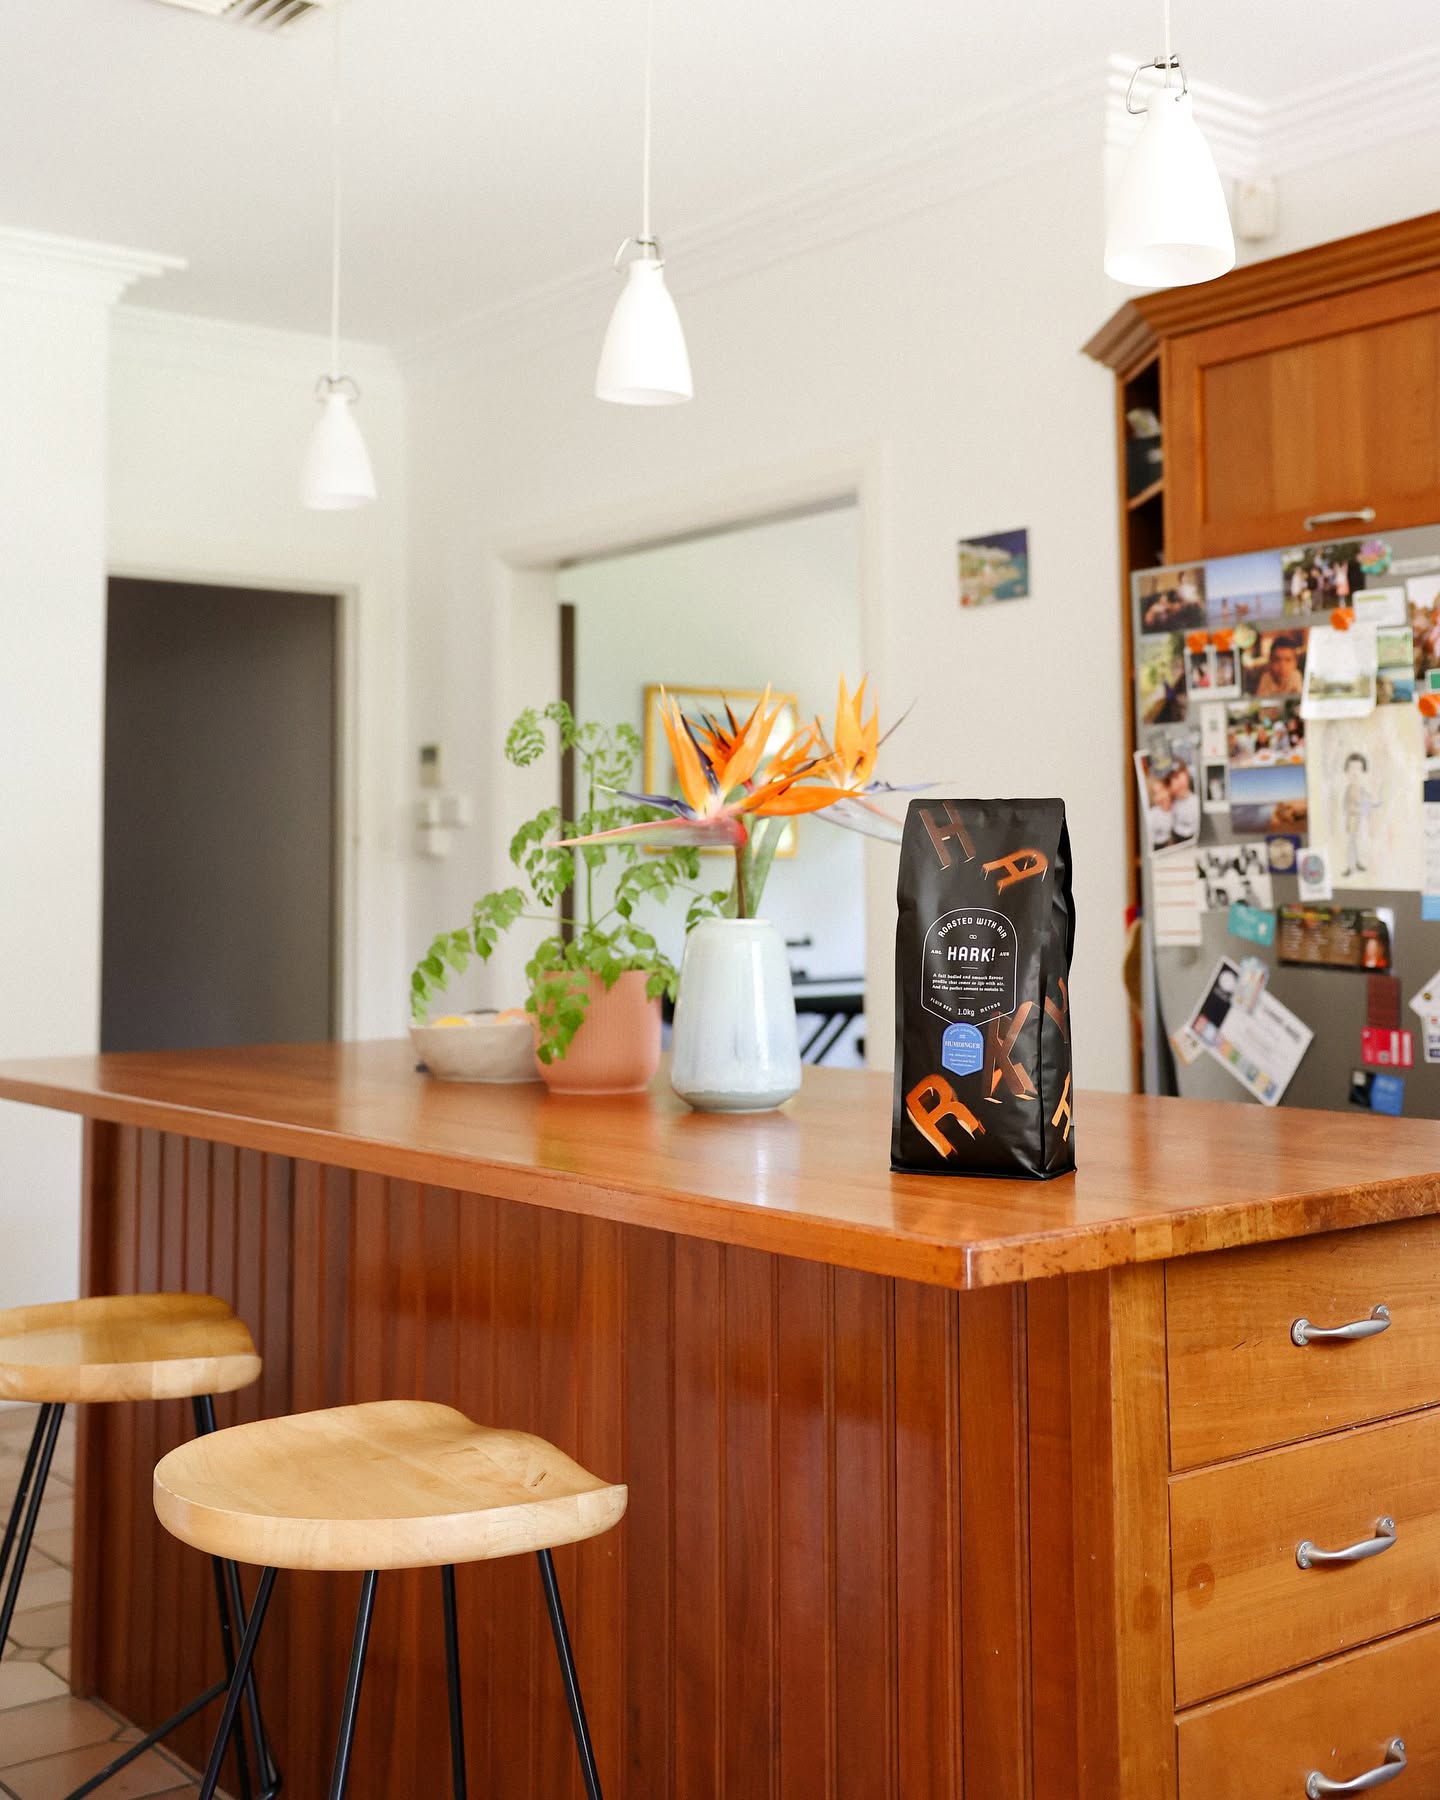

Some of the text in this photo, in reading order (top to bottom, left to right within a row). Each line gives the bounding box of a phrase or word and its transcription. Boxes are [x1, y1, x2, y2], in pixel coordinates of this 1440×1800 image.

[918, 801, 975, 871] H
[938, 917, 1008, 938] ROASTED WITH AIR
[947, 946, 996, 962] HARK!
[957, 1008, 975, 1017] 1.0kg
[980, 1001, 1001, 1013] METHOD
[906, 1074, 986, 1160] R
